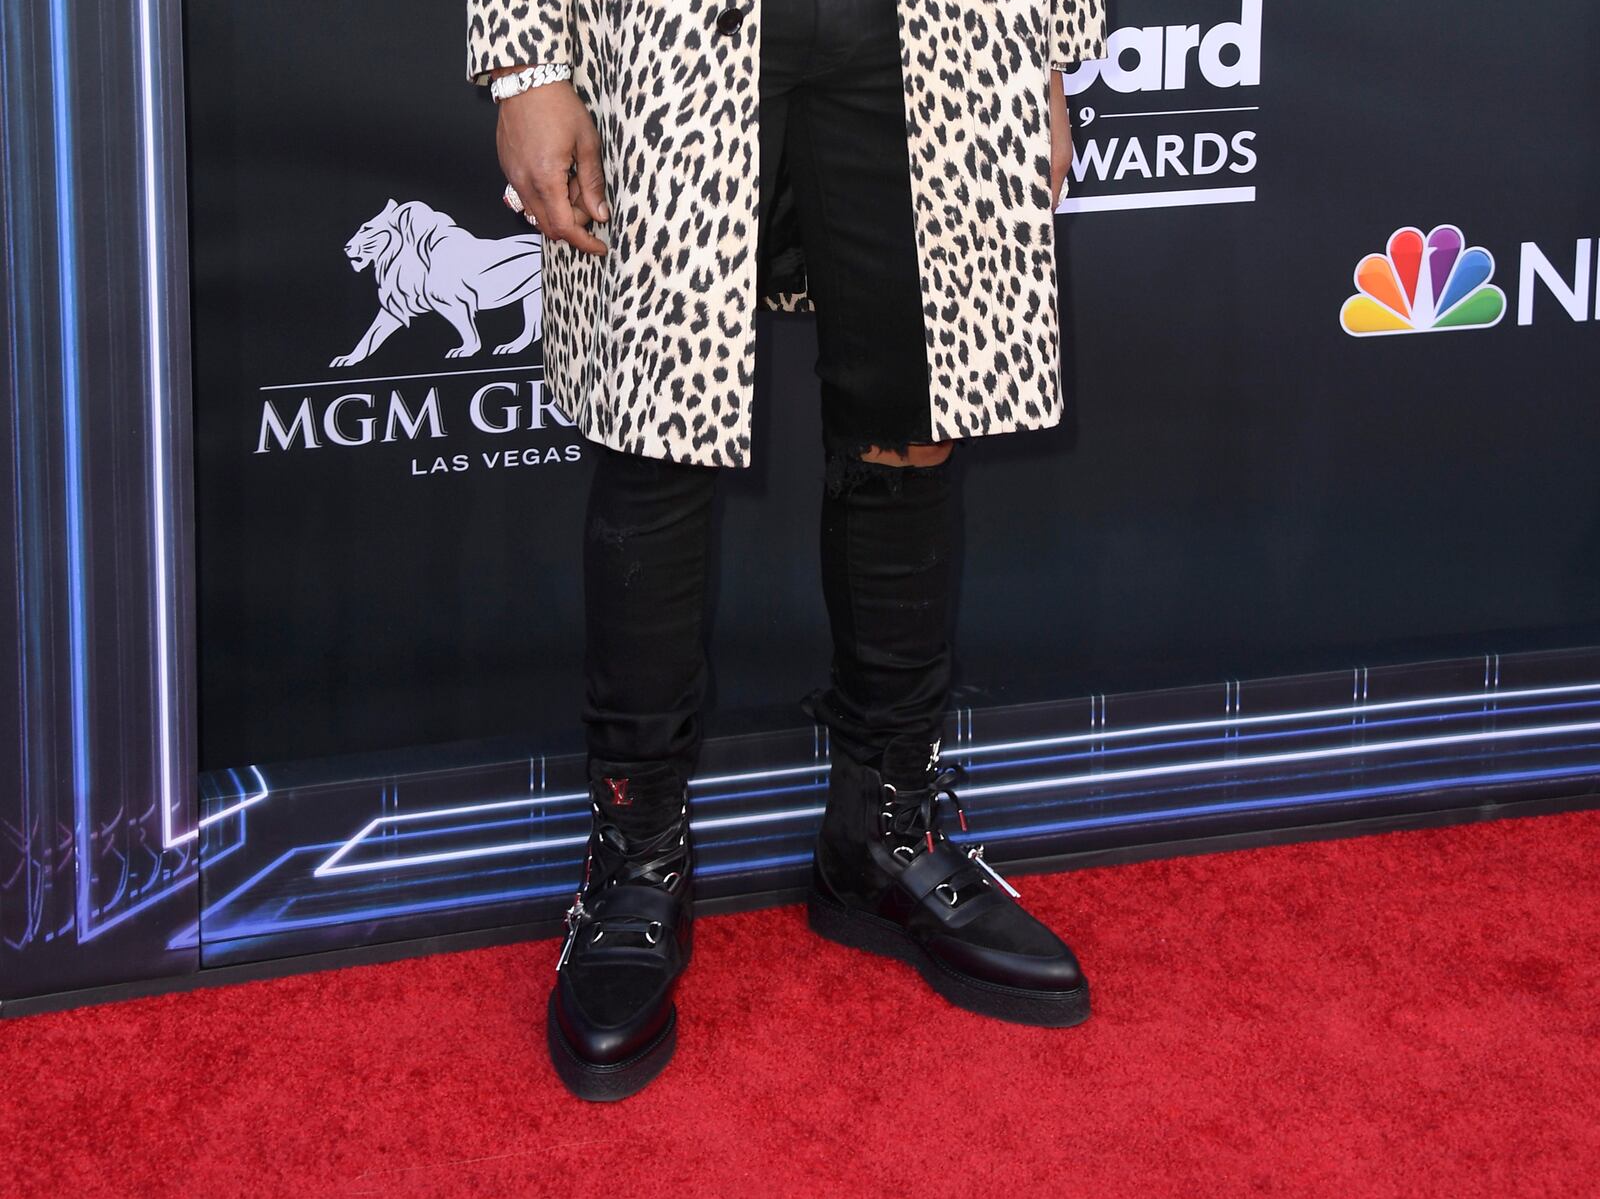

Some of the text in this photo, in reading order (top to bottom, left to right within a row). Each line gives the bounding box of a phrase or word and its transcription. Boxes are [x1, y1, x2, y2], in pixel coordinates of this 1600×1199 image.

[1071, 131, 1258, 182] WARDS
[1517, 237, 1600, 326] N
[253, 386, 448, 454] MGM
[412, 445, 582, 476] LAS VEGAS
